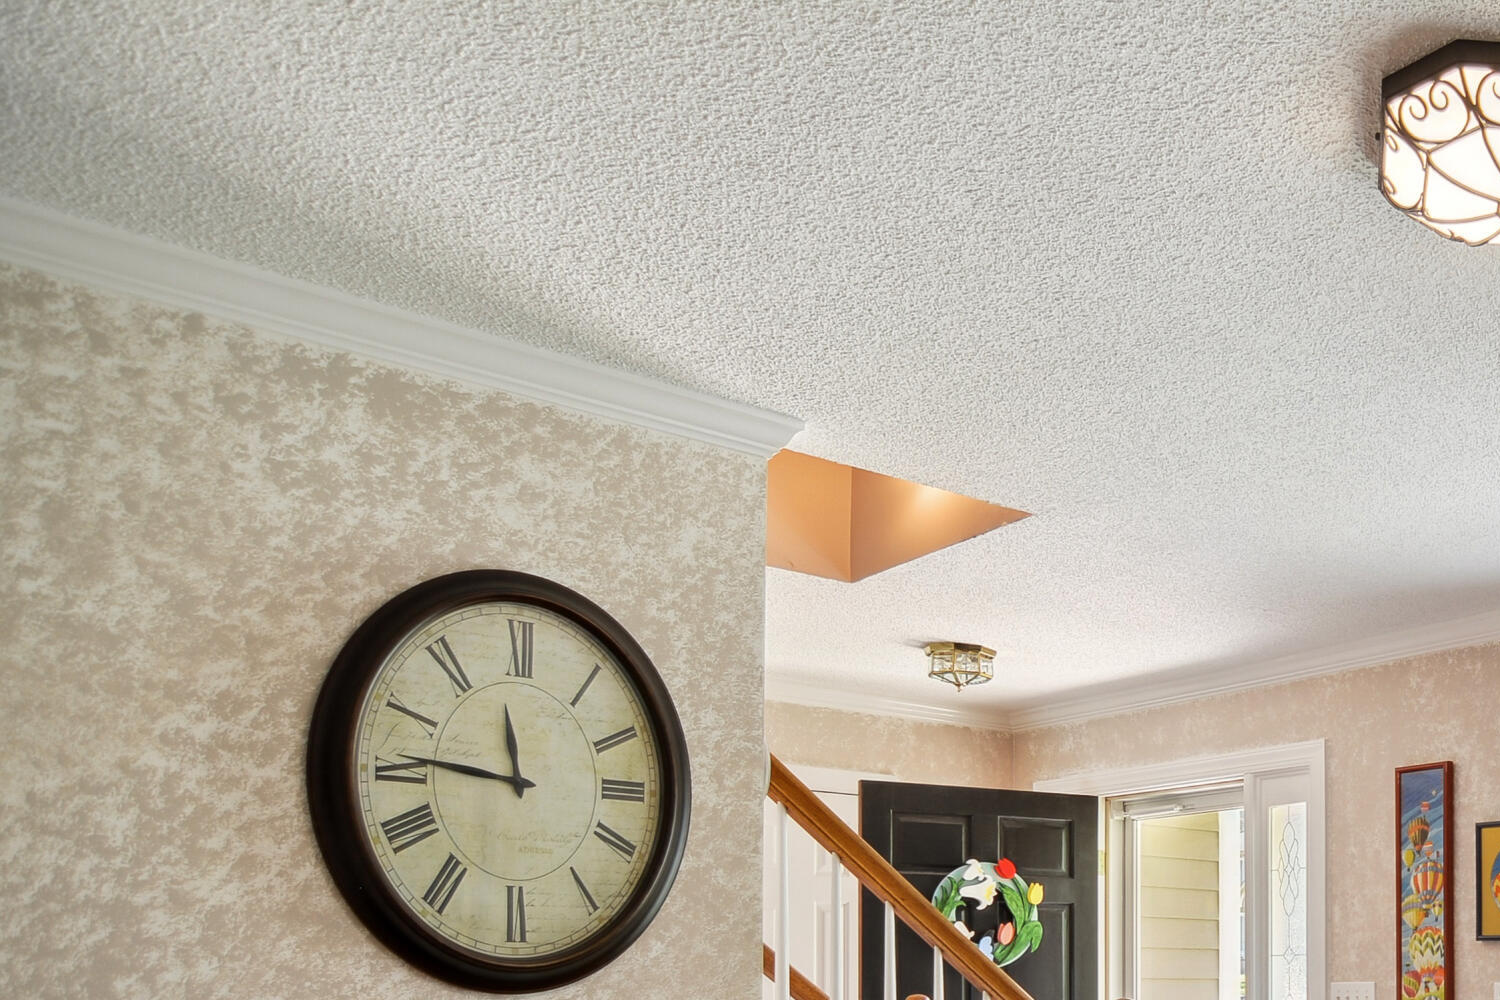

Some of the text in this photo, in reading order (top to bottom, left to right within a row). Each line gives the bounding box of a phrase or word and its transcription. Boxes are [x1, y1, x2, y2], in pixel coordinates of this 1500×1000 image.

[425, 635, 474, 699] XI
[505, 619, 535, 679] XII
[570, 663, 602, 708] I
[386, 691, 440, 739] X
[593, 726, 640, 755] II
[375, 754, 429, 786] IX
[601, 776, 646, 803] III
[504, 884, 528, 943] VI
[570, 865, 601, 917] V
